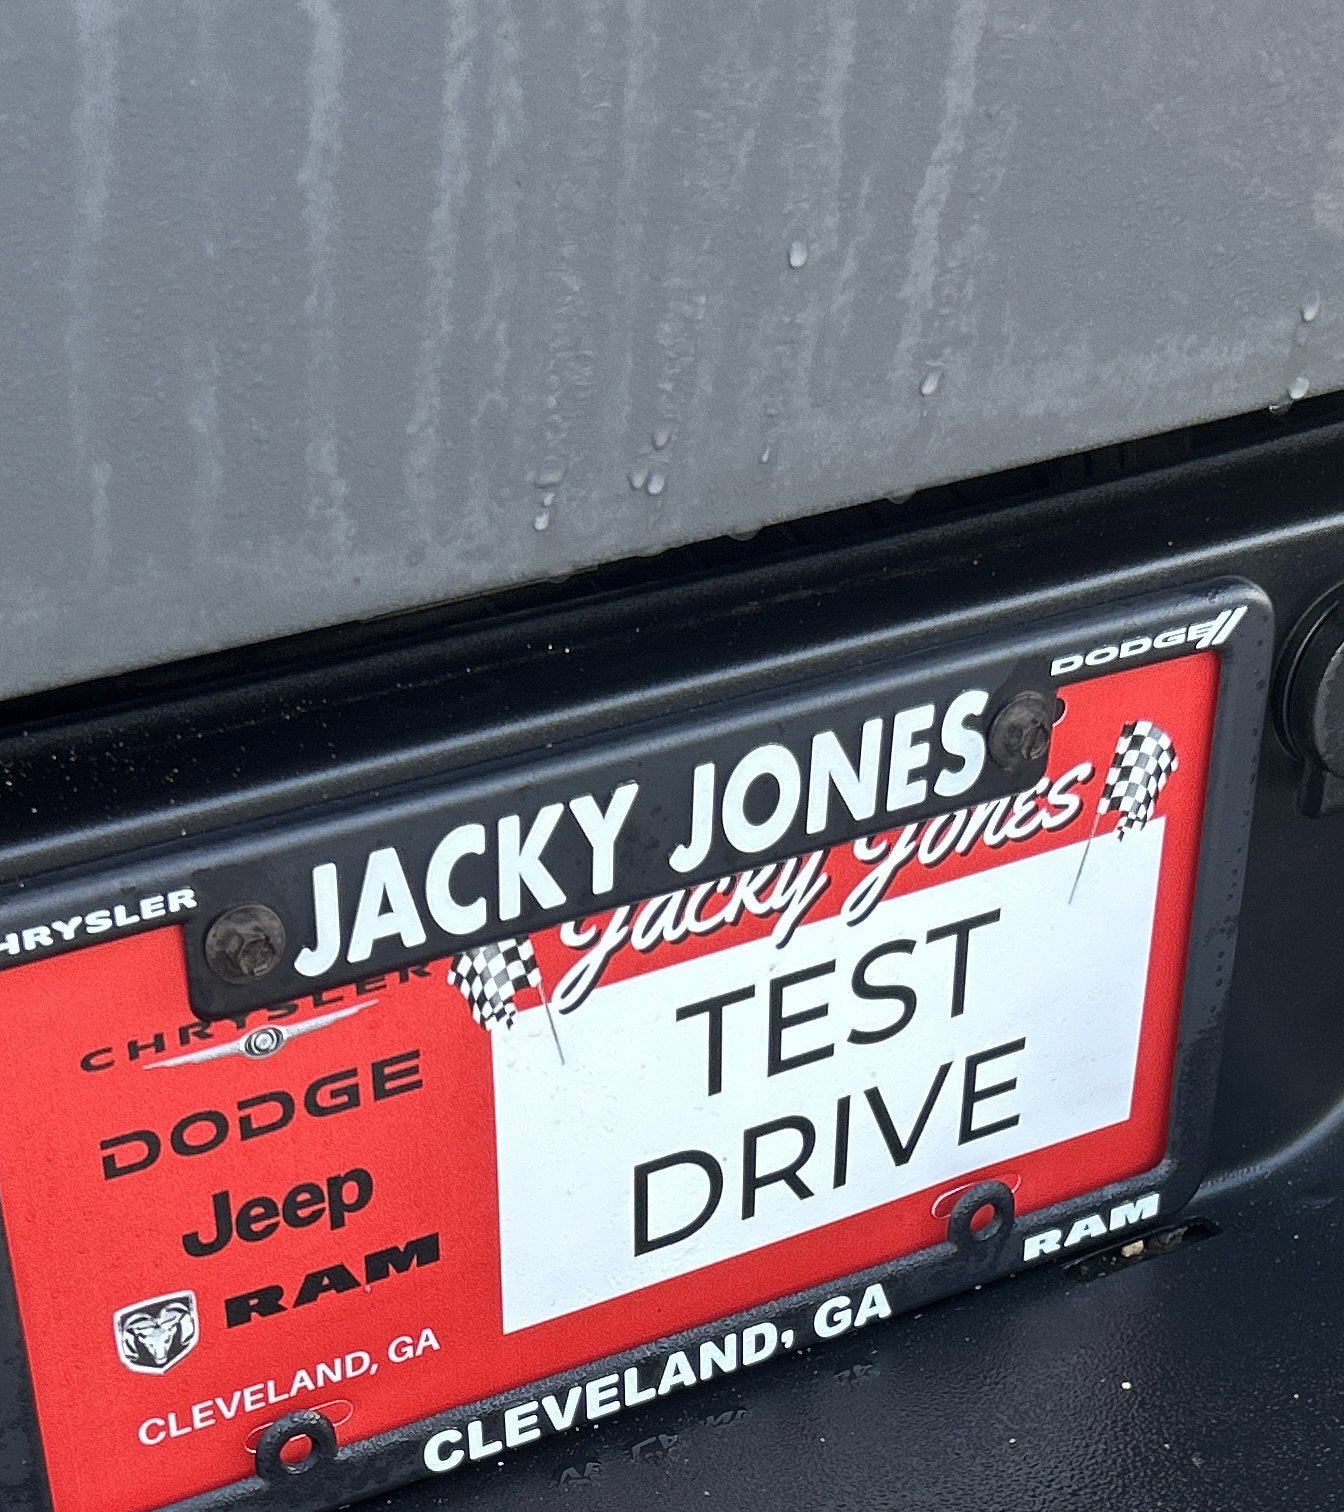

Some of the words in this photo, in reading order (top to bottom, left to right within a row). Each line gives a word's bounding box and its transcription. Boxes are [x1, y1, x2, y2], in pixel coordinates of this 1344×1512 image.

[294, 781, 640, 978] JACKY
[669, 690, 989, 874] JONES
[674, 907, 1002, 1099] TEST
[99, 1049, 424, 1181] DODGE
[632, 1036, 1028, 1259] DRIVE
[182, 1165, 375, 1259] Jeep
[1022, 1192, 1161, 1263] RAM
[224, 1232, 441, 1330] RAM
[137, 1349, 379, 1448] CLEVELAND,
[387, 1327, 442, 1368] GA
[422, 1321, 795, 1474] CLEVELAND,
[812, 1282, 893, 1339] GA
